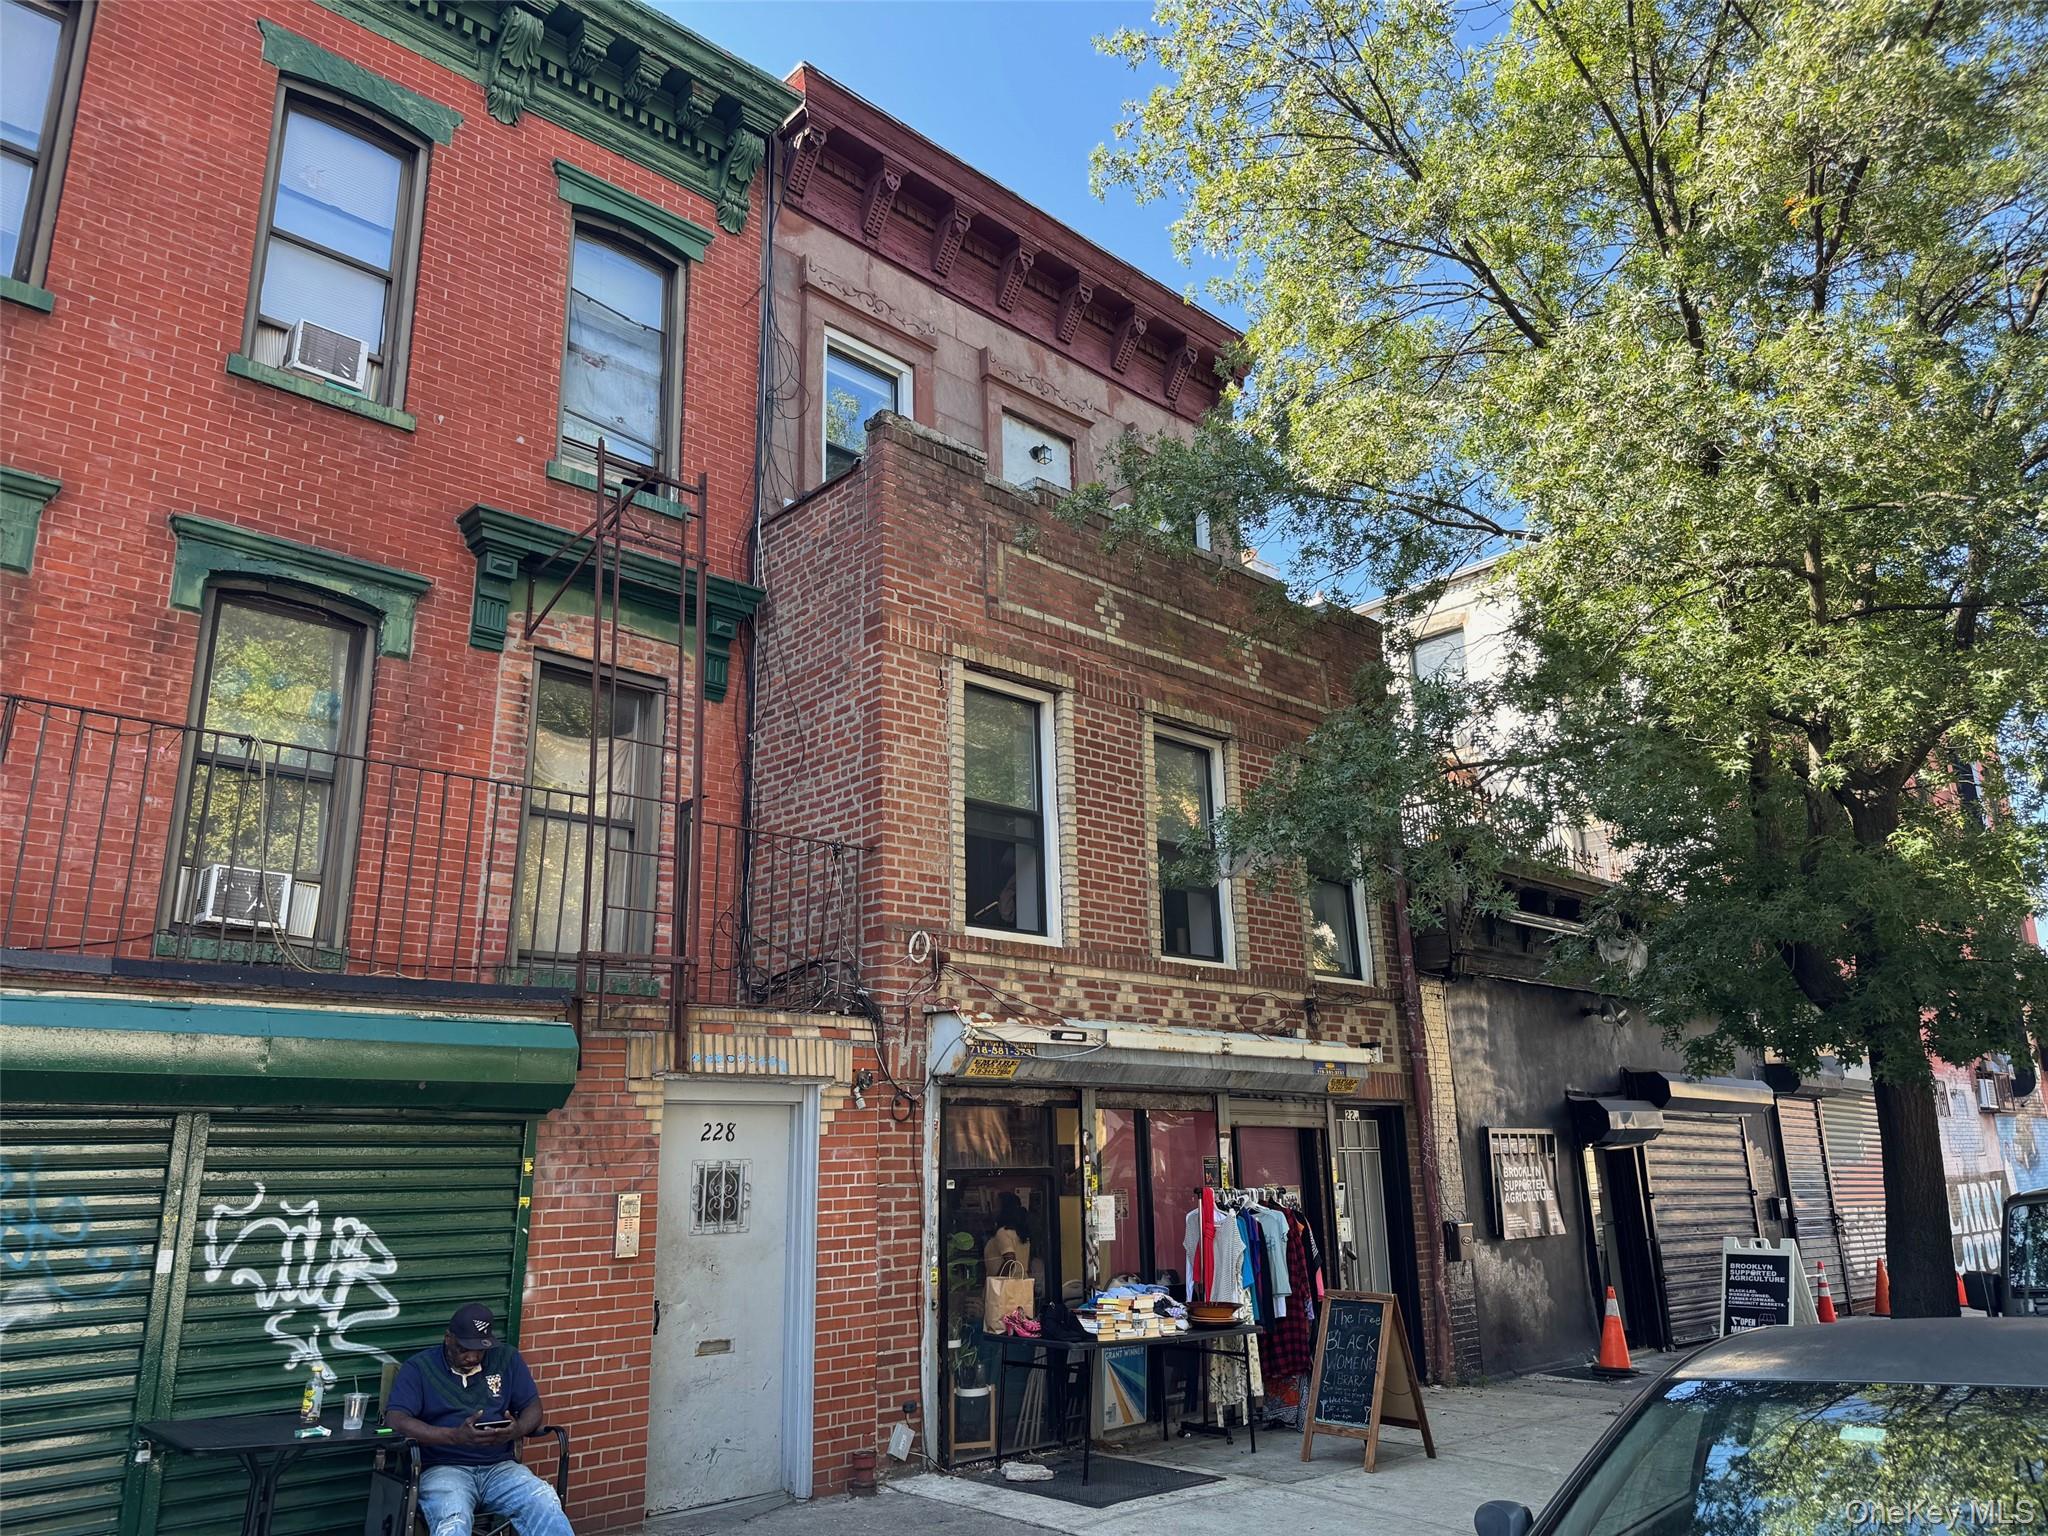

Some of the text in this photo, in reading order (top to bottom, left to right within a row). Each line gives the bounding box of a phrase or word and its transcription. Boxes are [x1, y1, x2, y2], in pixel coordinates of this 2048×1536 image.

[700, 1122, 737, 1142] 228
[1503, 1166, 1542, 1178] BROOKLYN
[1504, 1179, 1547, 1191] SUPPORTED
[1729, 1262, 1773, 1271] BROOKLYN
[1729, 1269, 1777, 1277] SUPPORTED
[1729, 1275, 1786, 1283] AGRICULTURE
[1331, 1308, 1381, 1326] The Free
[1740, 1317, 1756, 1327] OPEN
[1325, 1329, 1377, 1353] BLACK
